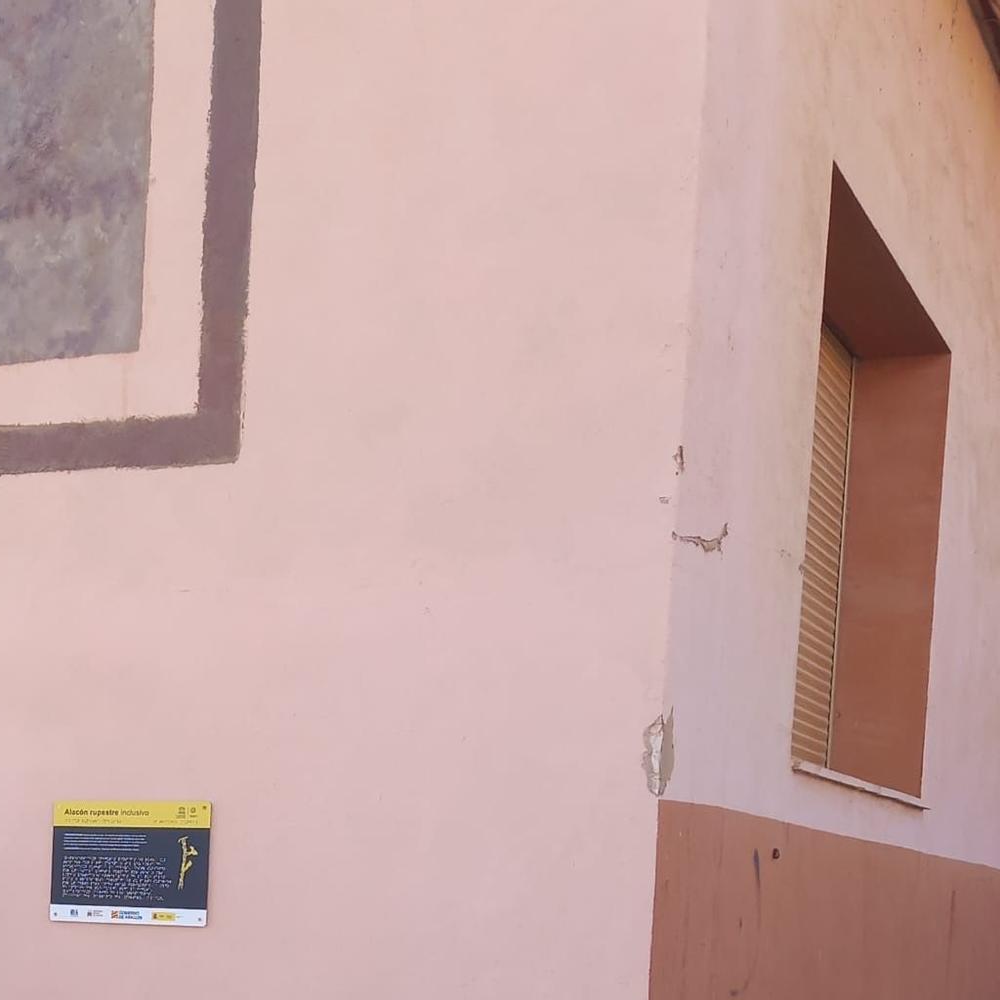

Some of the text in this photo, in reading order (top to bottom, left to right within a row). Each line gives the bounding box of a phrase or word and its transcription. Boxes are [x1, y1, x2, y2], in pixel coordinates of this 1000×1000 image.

[64, 808, 149, 817] Alacón rupestre inclusivo
